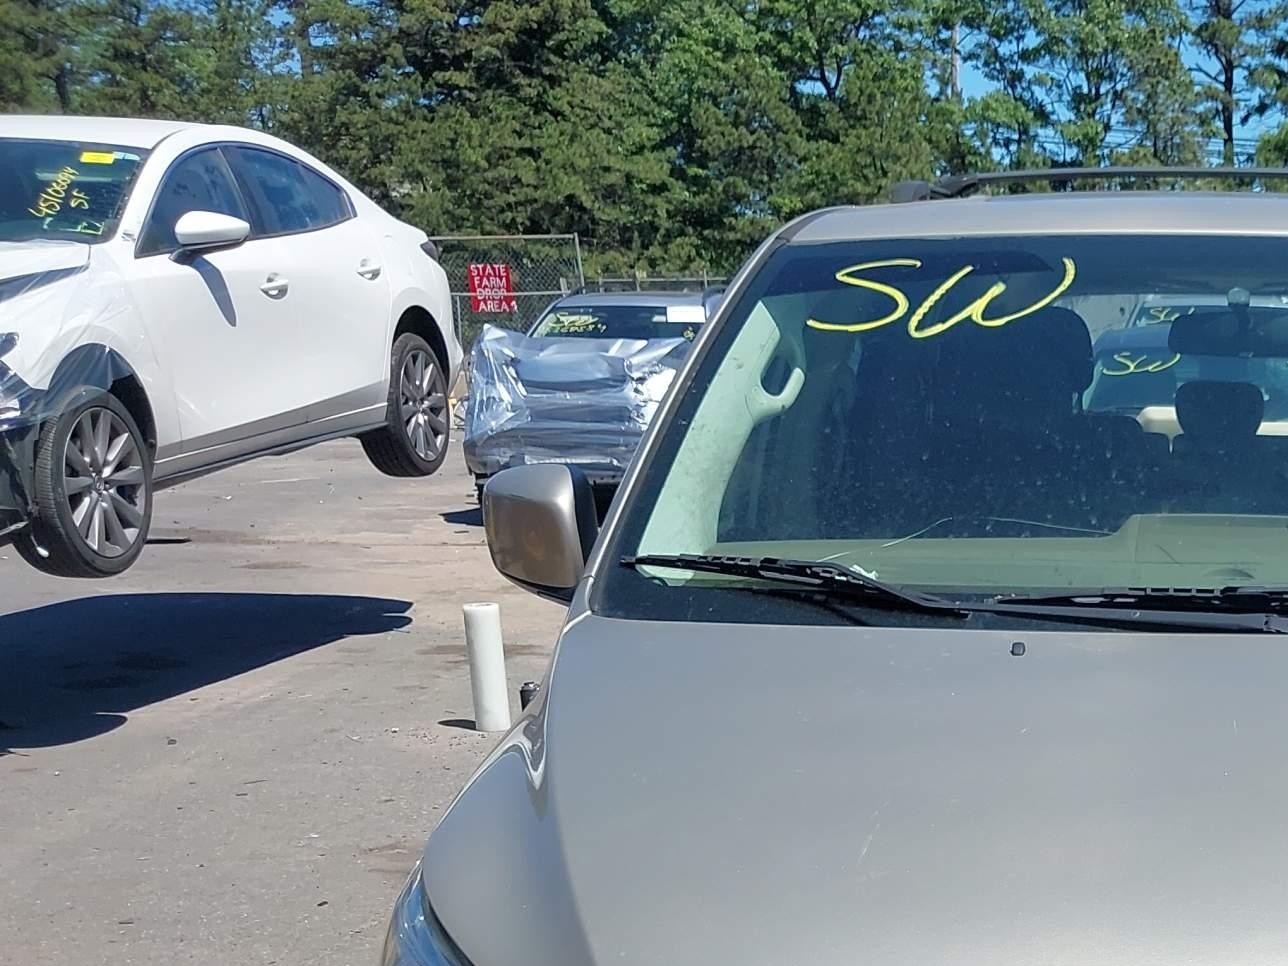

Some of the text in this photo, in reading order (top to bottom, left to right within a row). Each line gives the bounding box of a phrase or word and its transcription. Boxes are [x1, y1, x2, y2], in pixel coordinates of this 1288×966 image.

[70, 188, 90, 210] SF
[470, 264, 507, 276] STATE
[474, 276, 507, 290] FARM
[476, 288, 508, 300] DROP
[806, 258, 1076, 338] SW
[479, 300, 510, 313] AREA
[1102, 351, 1181, 375] SW
